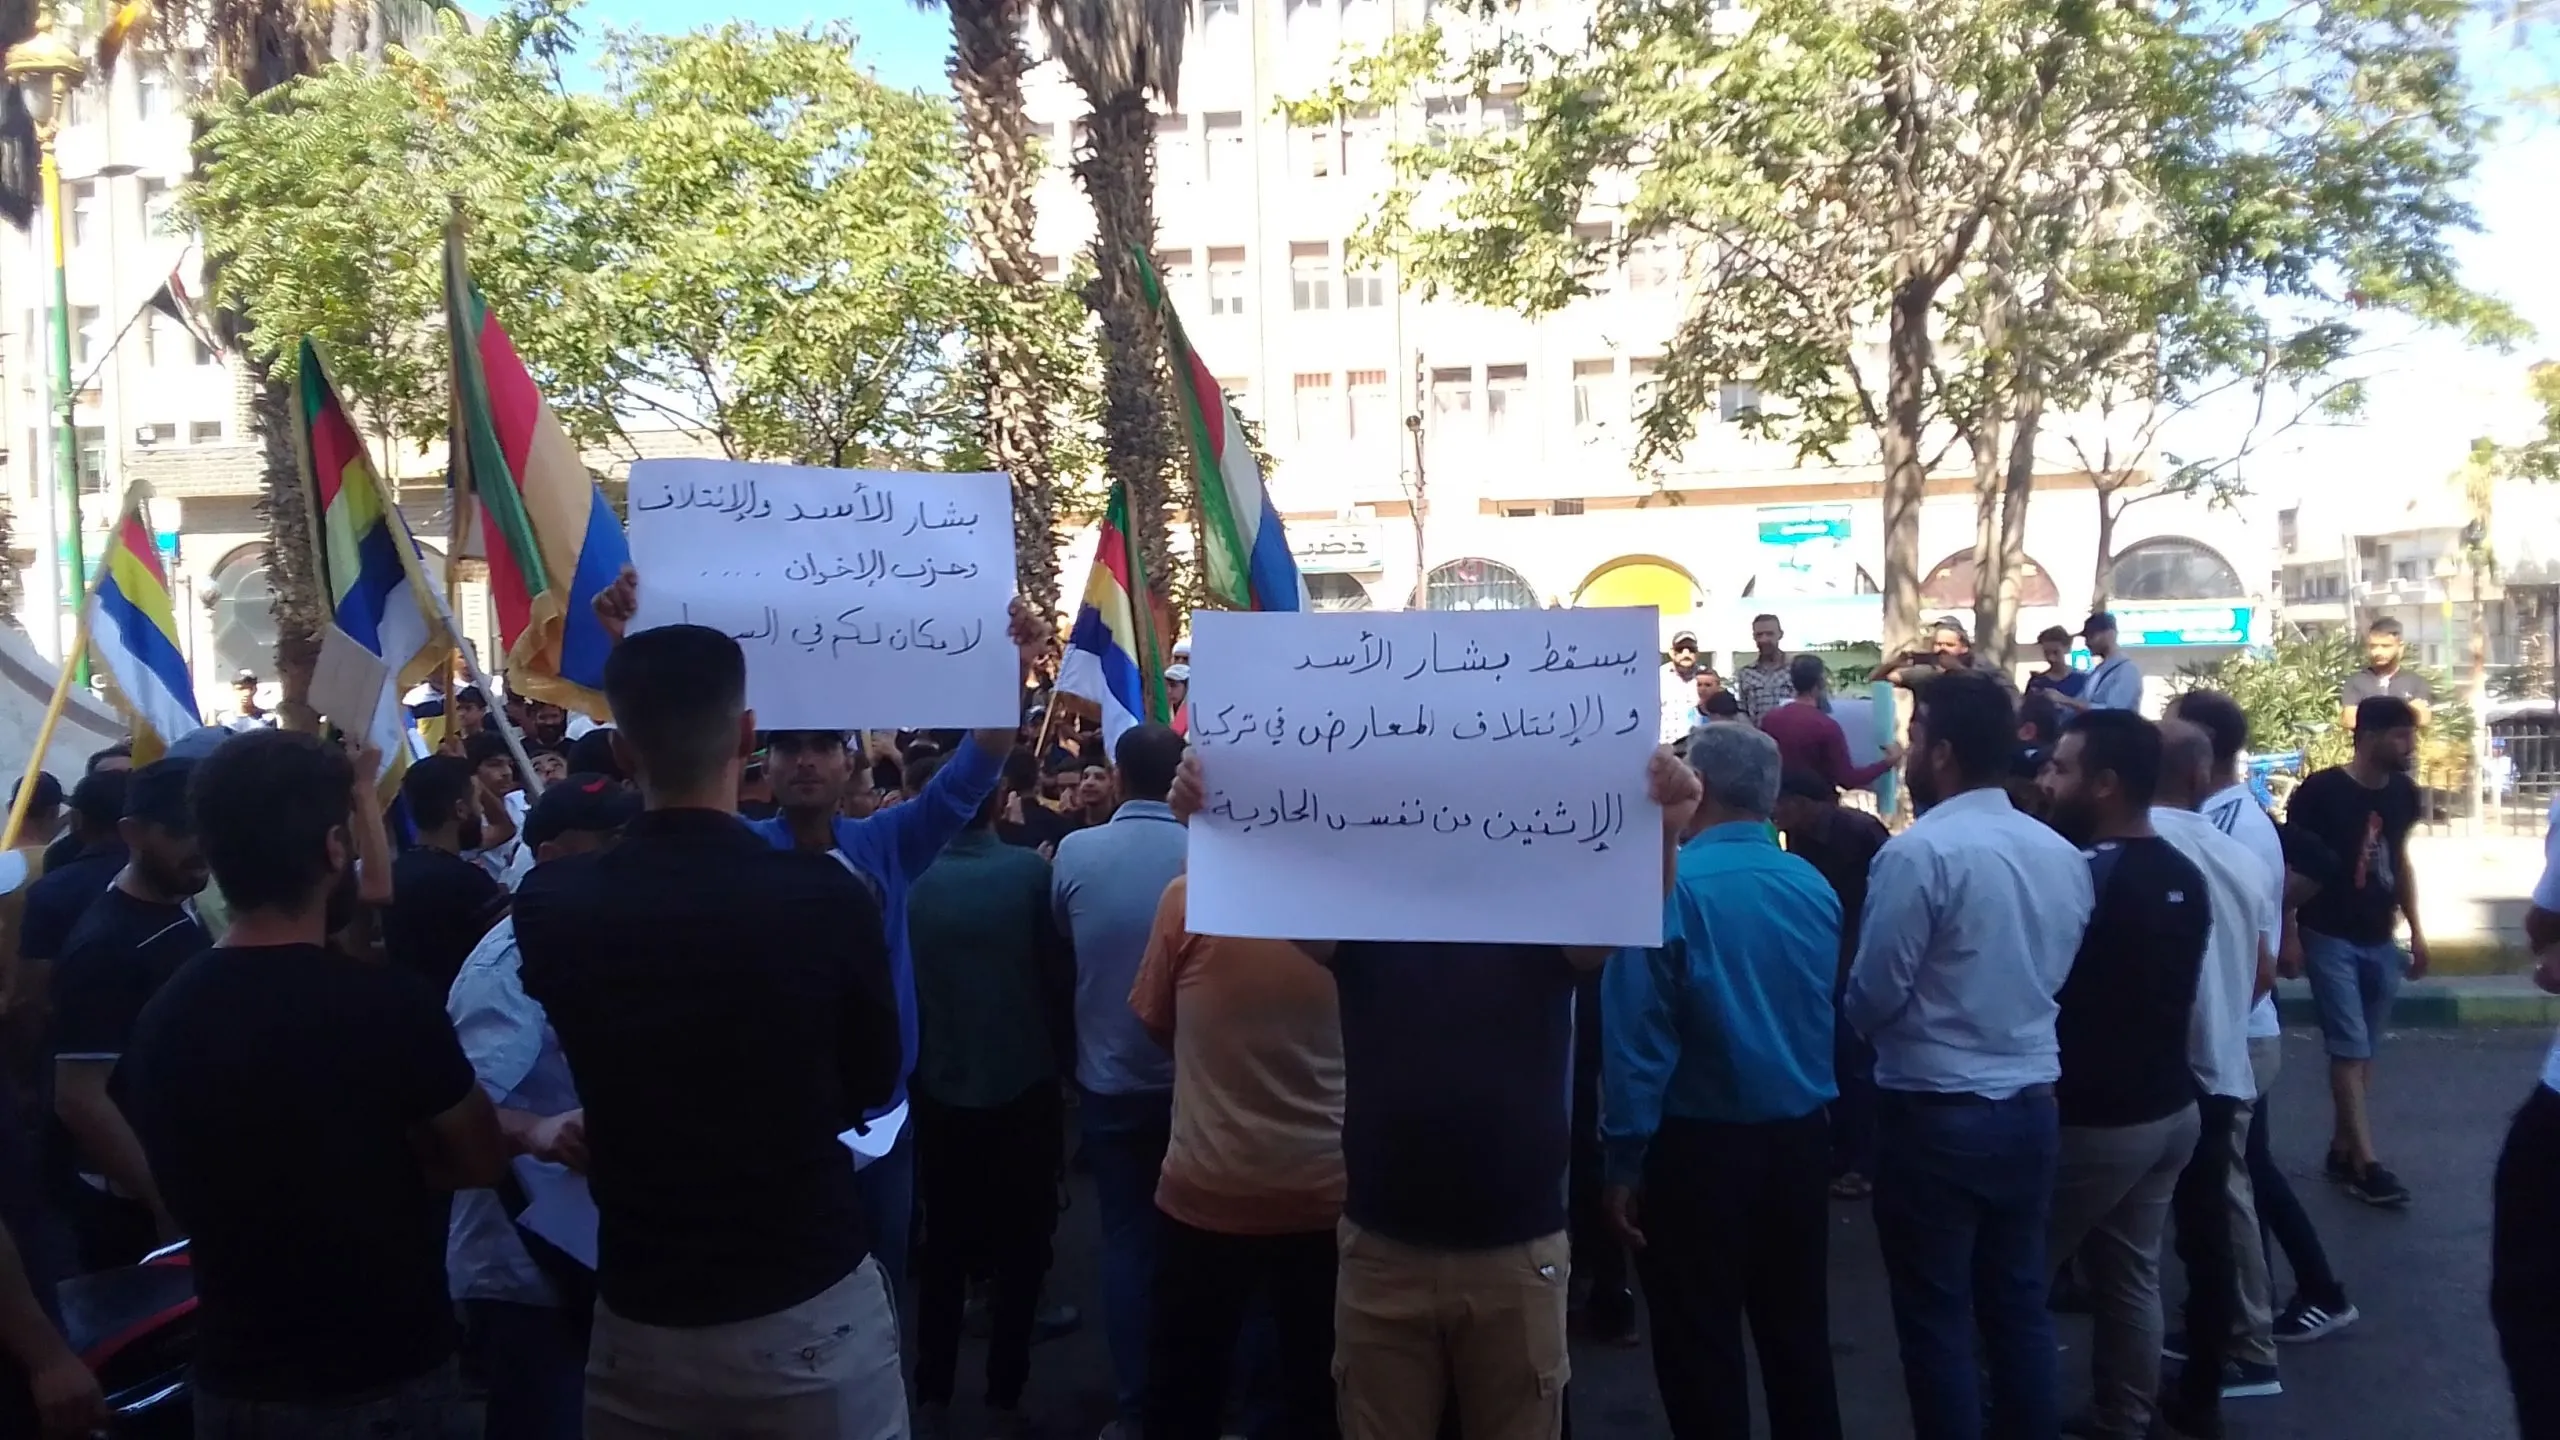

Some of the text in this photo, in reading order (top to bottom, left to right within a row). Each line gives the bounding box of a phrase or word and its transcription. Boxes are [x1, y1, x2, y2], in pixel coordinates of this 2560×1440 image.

[784, 482, 893, 523] الأسد
[902, 501, 979, 536] بشار
[891, 558, 978, 588] وحزب
[791, 616, 823, 652] في
[832, 606, 882, 660] لكم
[889, 618, 948, 651] مكان
[946, 618, 982, 656] لا
[1294, 630, 1638, 682] يسقط بشار الأسد
[1192, 702, 1257, 745] تركيا
[1265, 706, 1285, 746] في
[1298, 704, 1436, 753] المعارض
[1211, 788, 1624, 852] الإثنين من نفس الحاوية
